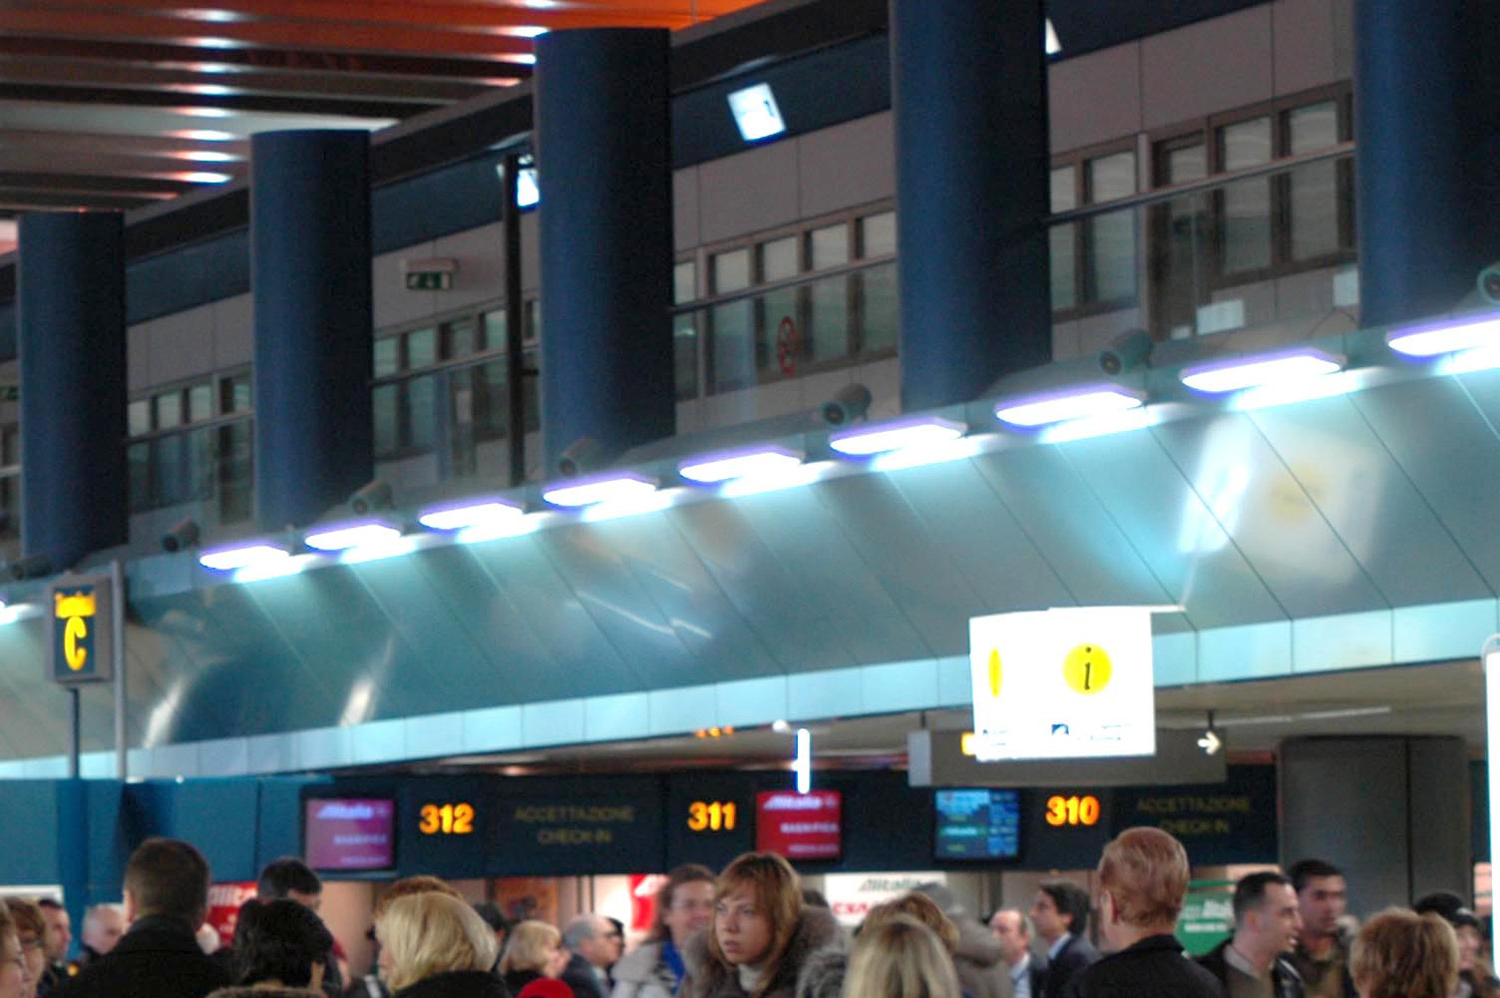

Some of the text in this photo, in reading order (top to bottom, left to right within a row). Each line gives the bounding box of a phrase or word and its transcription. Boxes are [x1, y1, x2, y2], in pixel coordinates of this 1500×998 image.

[419, 803, 475, 834] 312
[687, 801, 736, 831] 311
[1046, 795, 1099, 826] 310
